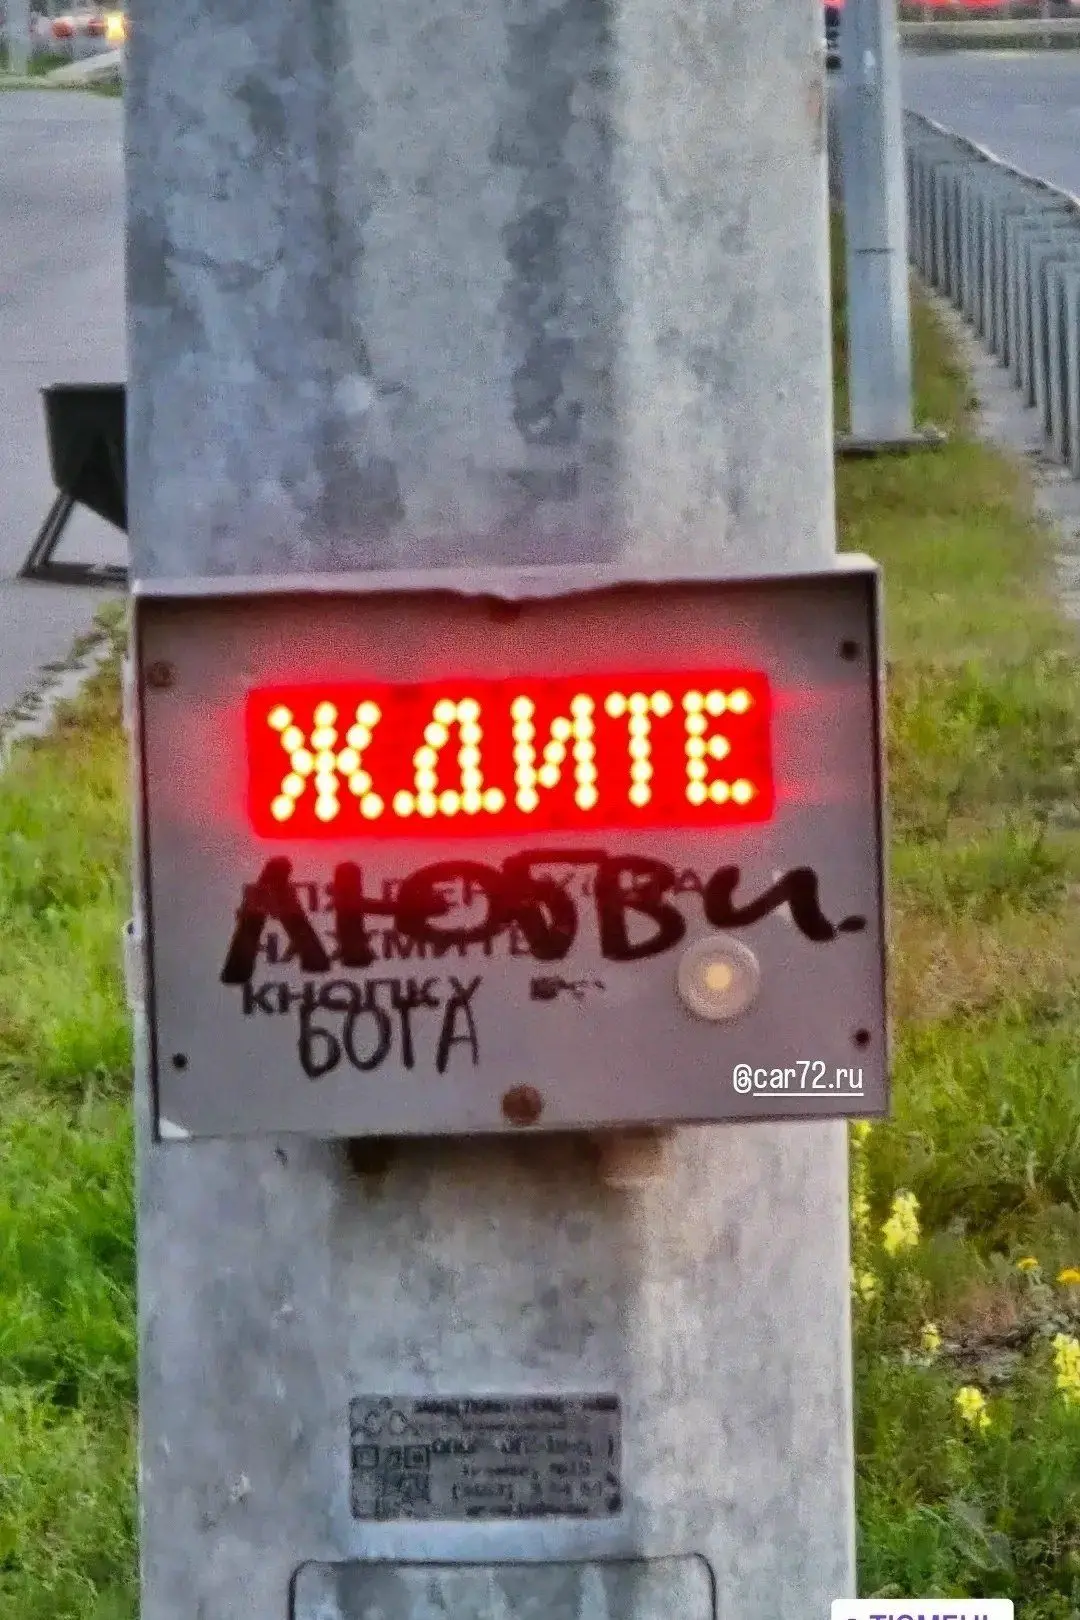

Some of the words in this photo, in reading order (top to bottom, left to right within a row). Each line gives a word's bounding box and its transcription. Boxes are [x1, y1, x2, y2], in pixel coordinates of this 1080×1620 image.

[268, 690, 756, 822] ЖДИТЕ
[243, 975, 484, 1014] КНОПКУ
[297, 996, 481, 1079] БОГА
